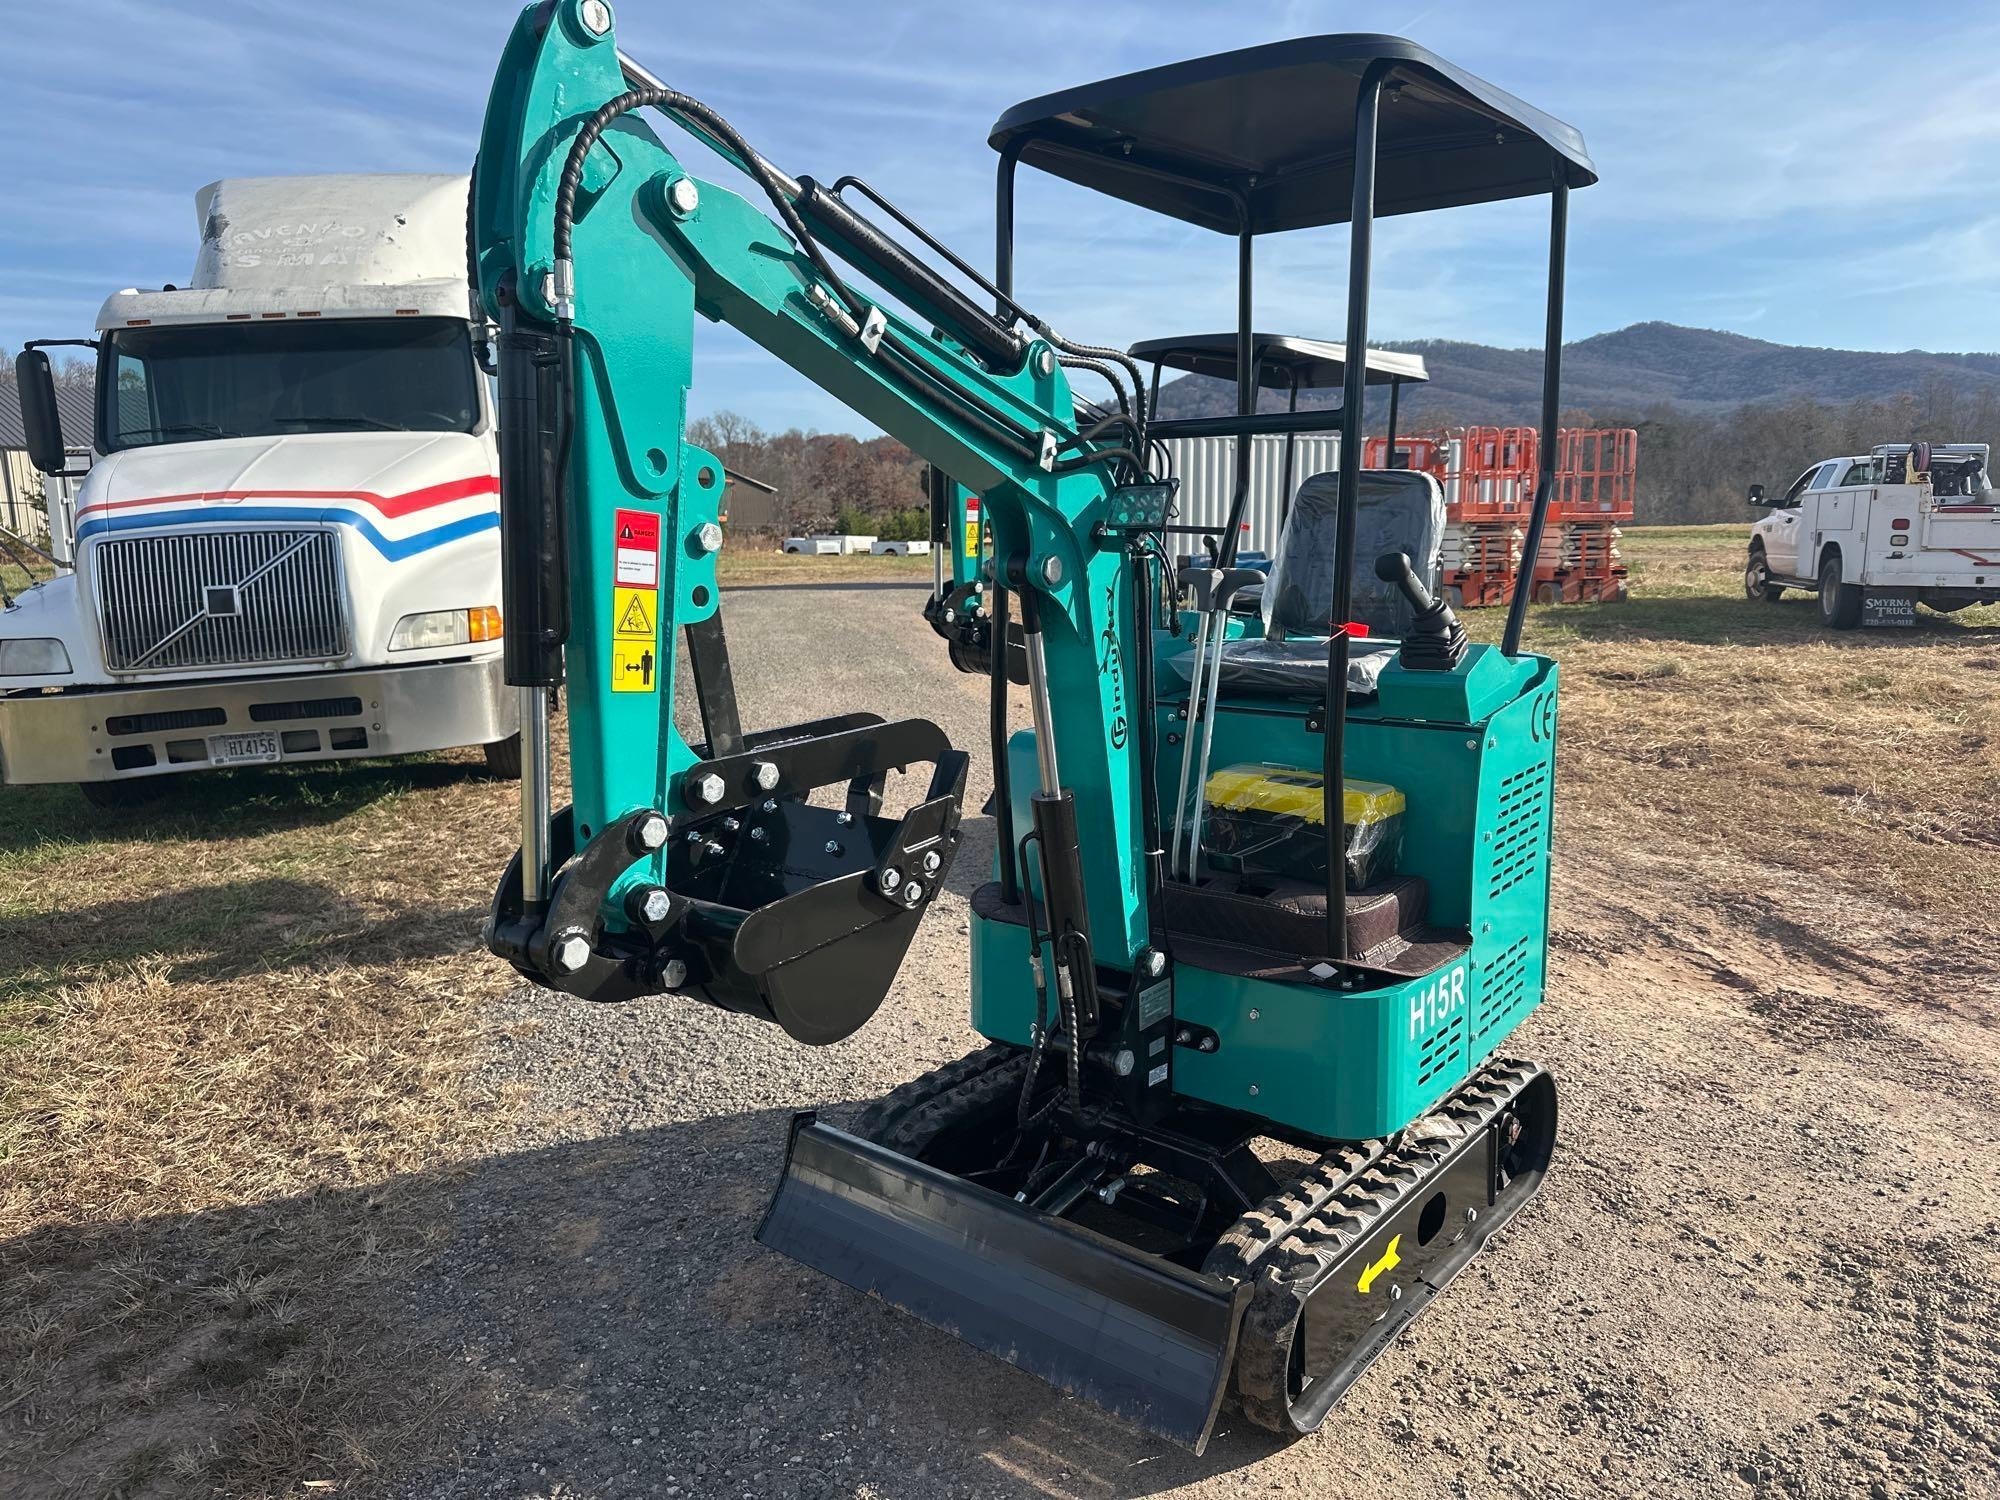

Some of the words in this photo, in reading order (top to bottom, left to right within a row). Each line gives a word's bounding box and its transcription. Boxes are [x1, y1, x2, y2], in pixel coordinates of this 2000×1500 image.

[1865, 598, 1911, 609] SMYRNA
[1875, 607, 1914, 617] TRUCK
[229, 738, 276, 755] HI4156
[1410, 965, 1466, 1042] H15R
